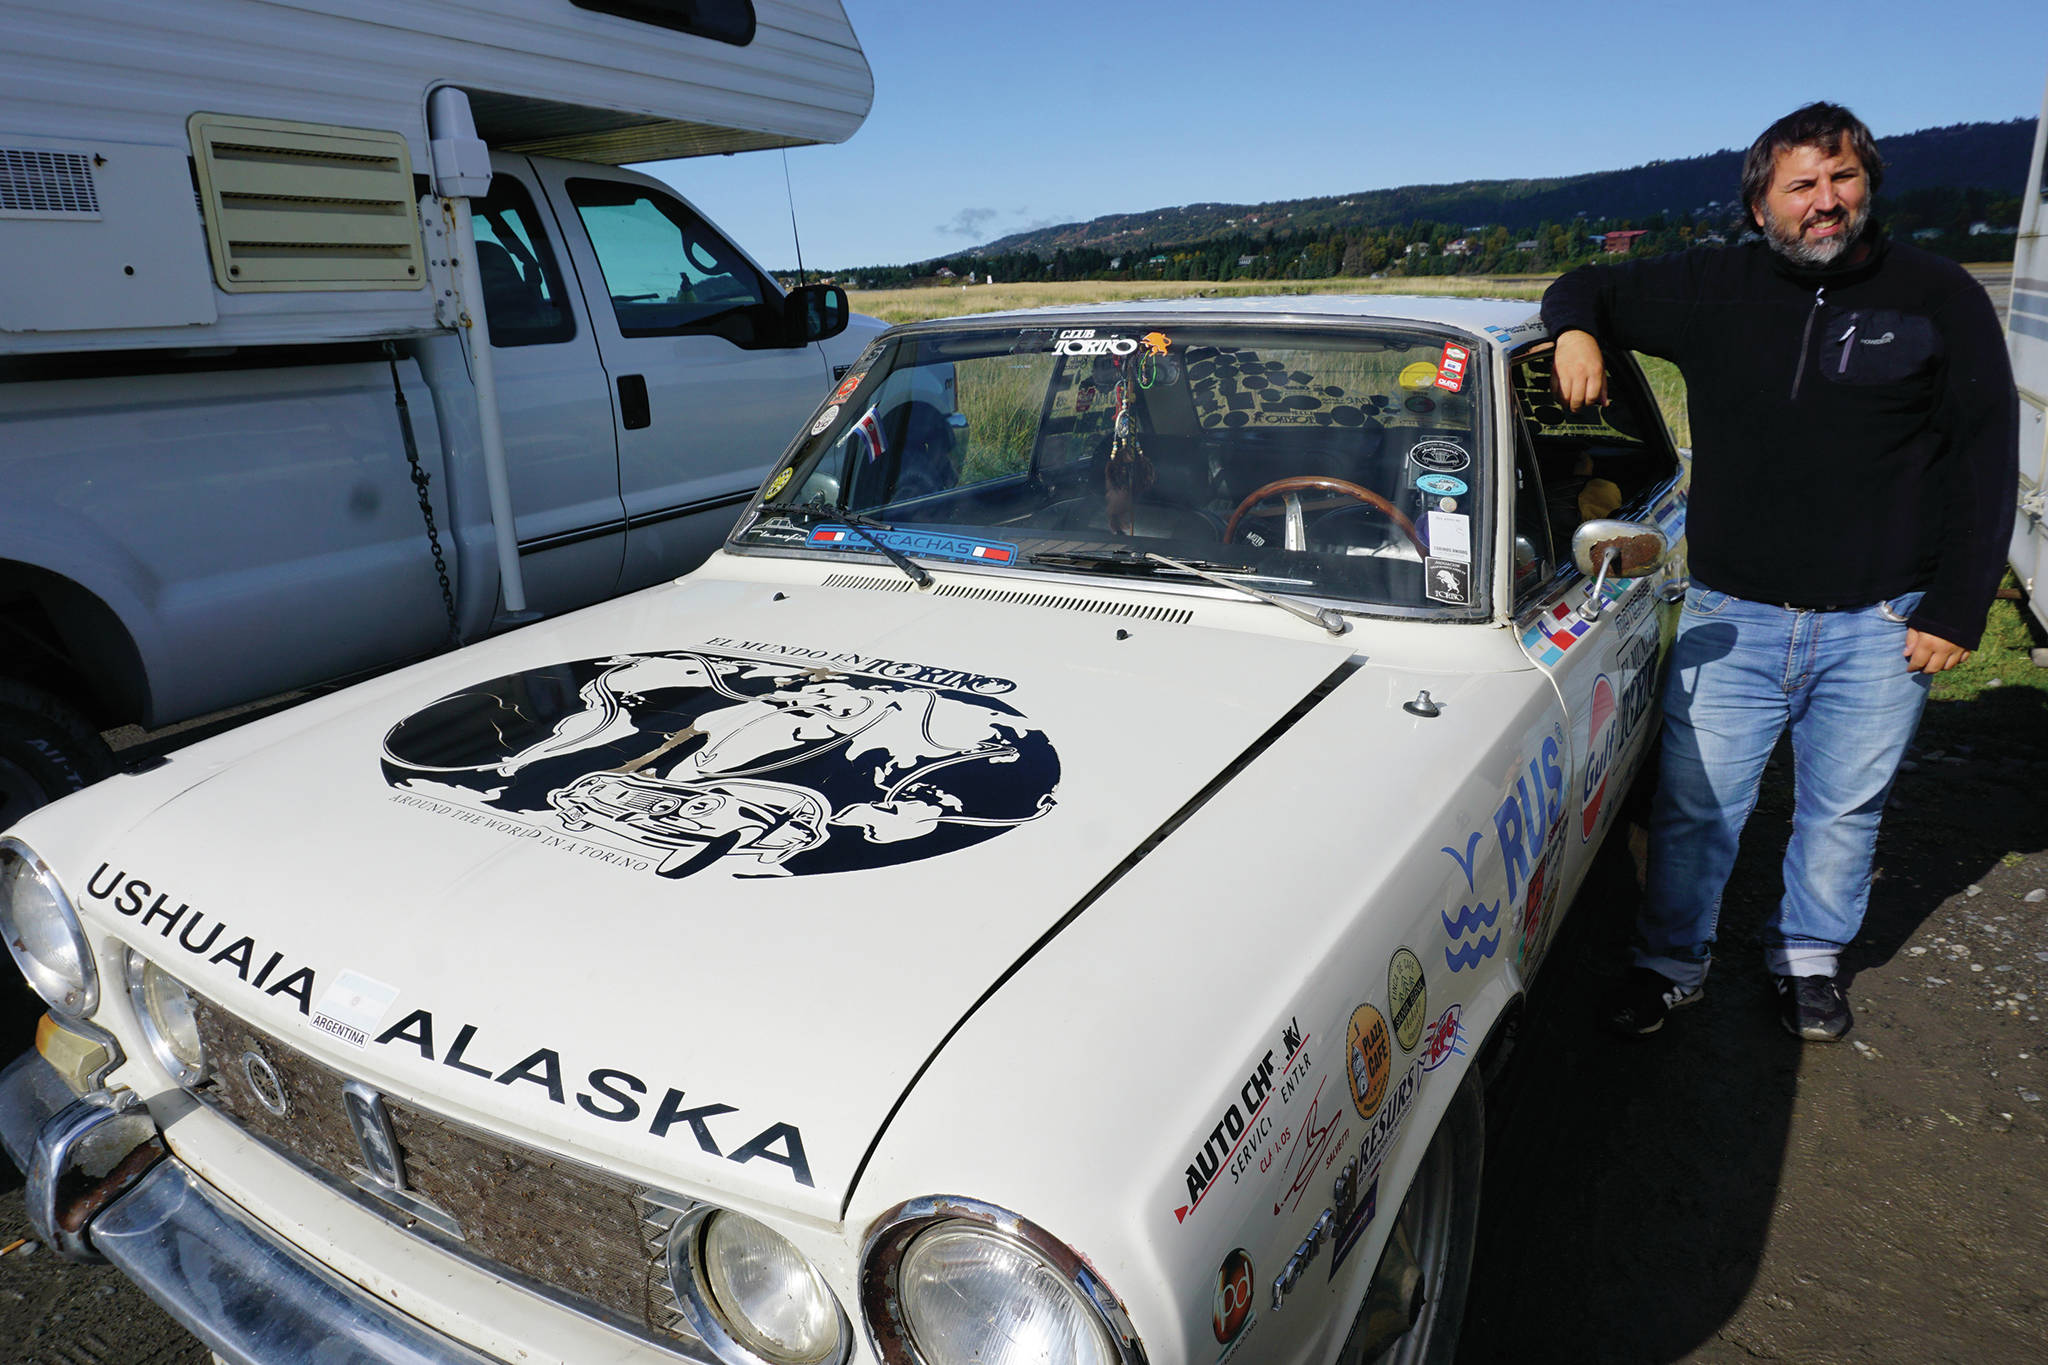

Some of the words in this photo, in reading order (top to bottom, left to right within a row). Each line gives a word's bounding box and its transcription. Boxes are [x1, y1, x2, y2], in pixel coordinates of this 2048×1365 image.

[1051, 338, 1138, 356] TORINO
[848, 532, 971, 554] CARCACHAS
[706, 637, 729, 647] EL
[731, 641, 829, 659] MUNDO
[856, 660, 1018, 695] TORINO
[1583, 720, 1617, 802] Gulf
[389, 794, 452, 815] AROUND
[452, 809, 487, 824] THE
[484, 818, 542, 839] WORLD
[541, 835, 564, 848] IN
[559, 842, 575, 852] A
[580, 845, 650, 872] TORINO
[1493, 735, 1563, 905] RUS
[86, 862, 316, 1017] USHUAIA
[313, 1015, 365, 1046] ARGENTINA
[1361, 1019, 1384, 1055] PLAZA
[375, 1008, 815, 1189] ALASKA
[1186, 1103, 1245, 1205] AUTO
